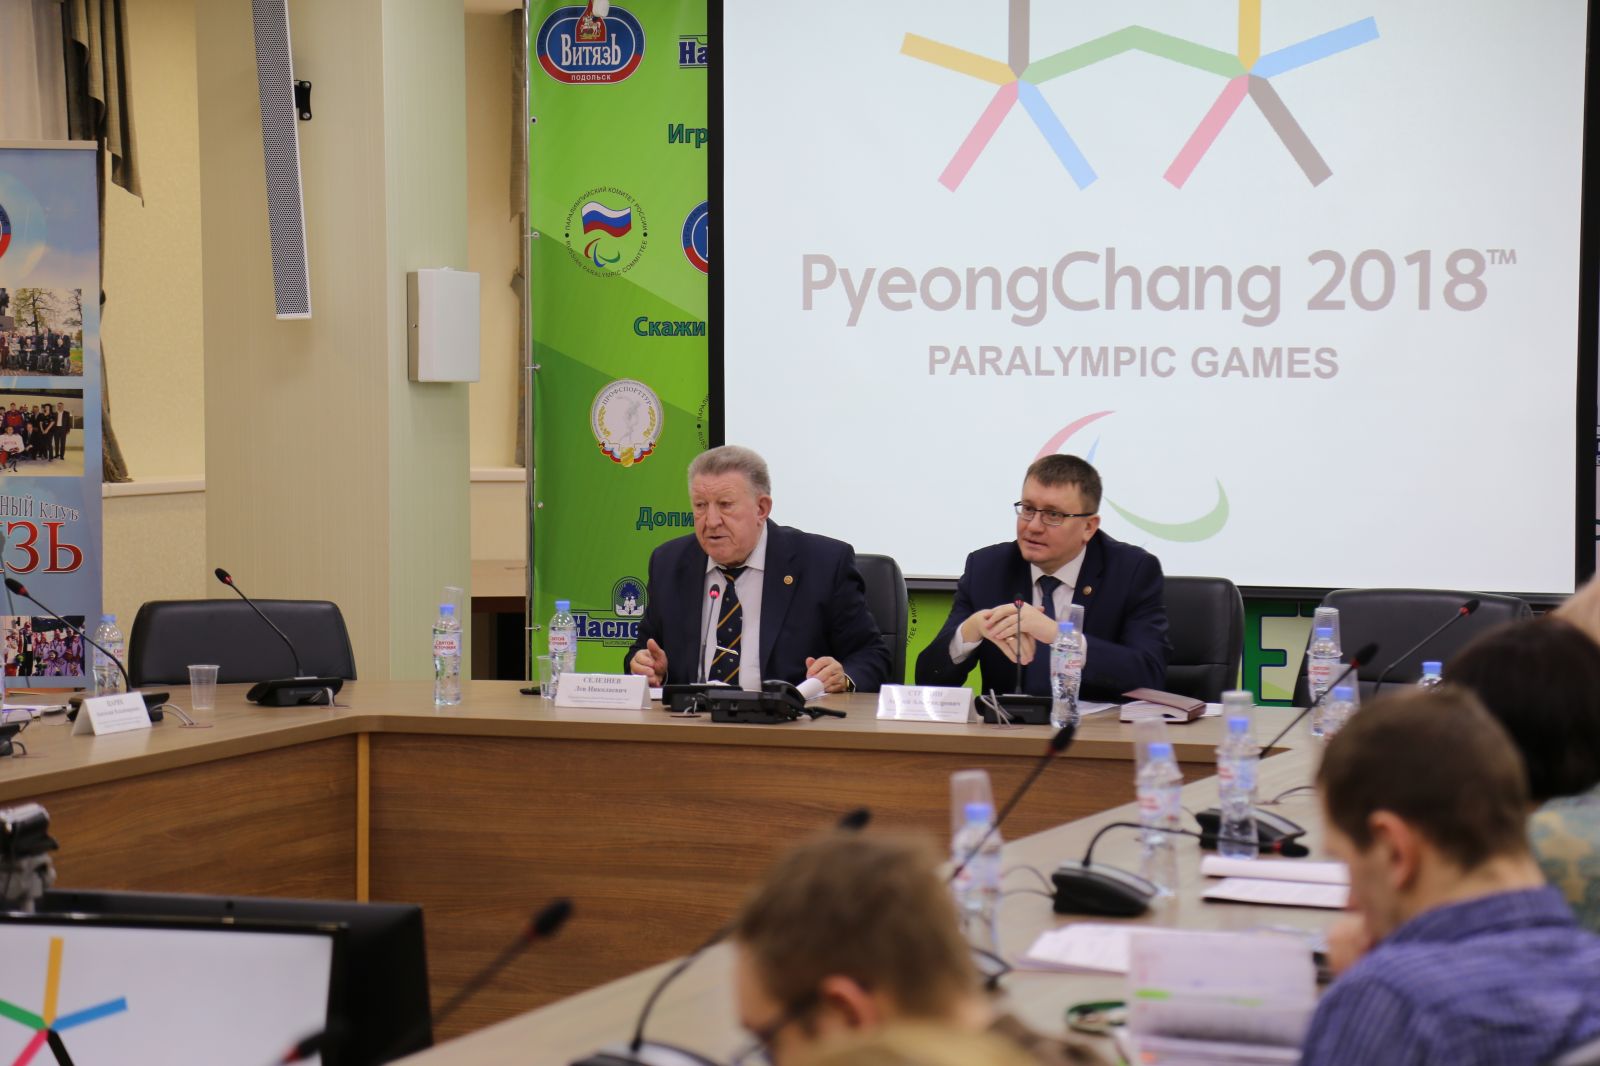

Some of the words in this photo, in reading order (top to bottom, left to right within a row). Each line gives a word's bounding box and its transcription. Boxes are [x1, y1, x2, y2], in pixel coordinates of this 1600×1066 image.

[608, 187, 635, 204] КОМИТЕТ
[634, 203, 649, 231] РОССИИ
[622, 240, 648, 273] COMMITTEE
[802, 247, 1281, 327] PyeongChang
[633, 316, 707, 337] Скажи
[928, 345, 1176, 378] PARALYMPIC
[1191, 346, 1339, 379] GAMES
[0, 520, 83, 574] ЗЬ
